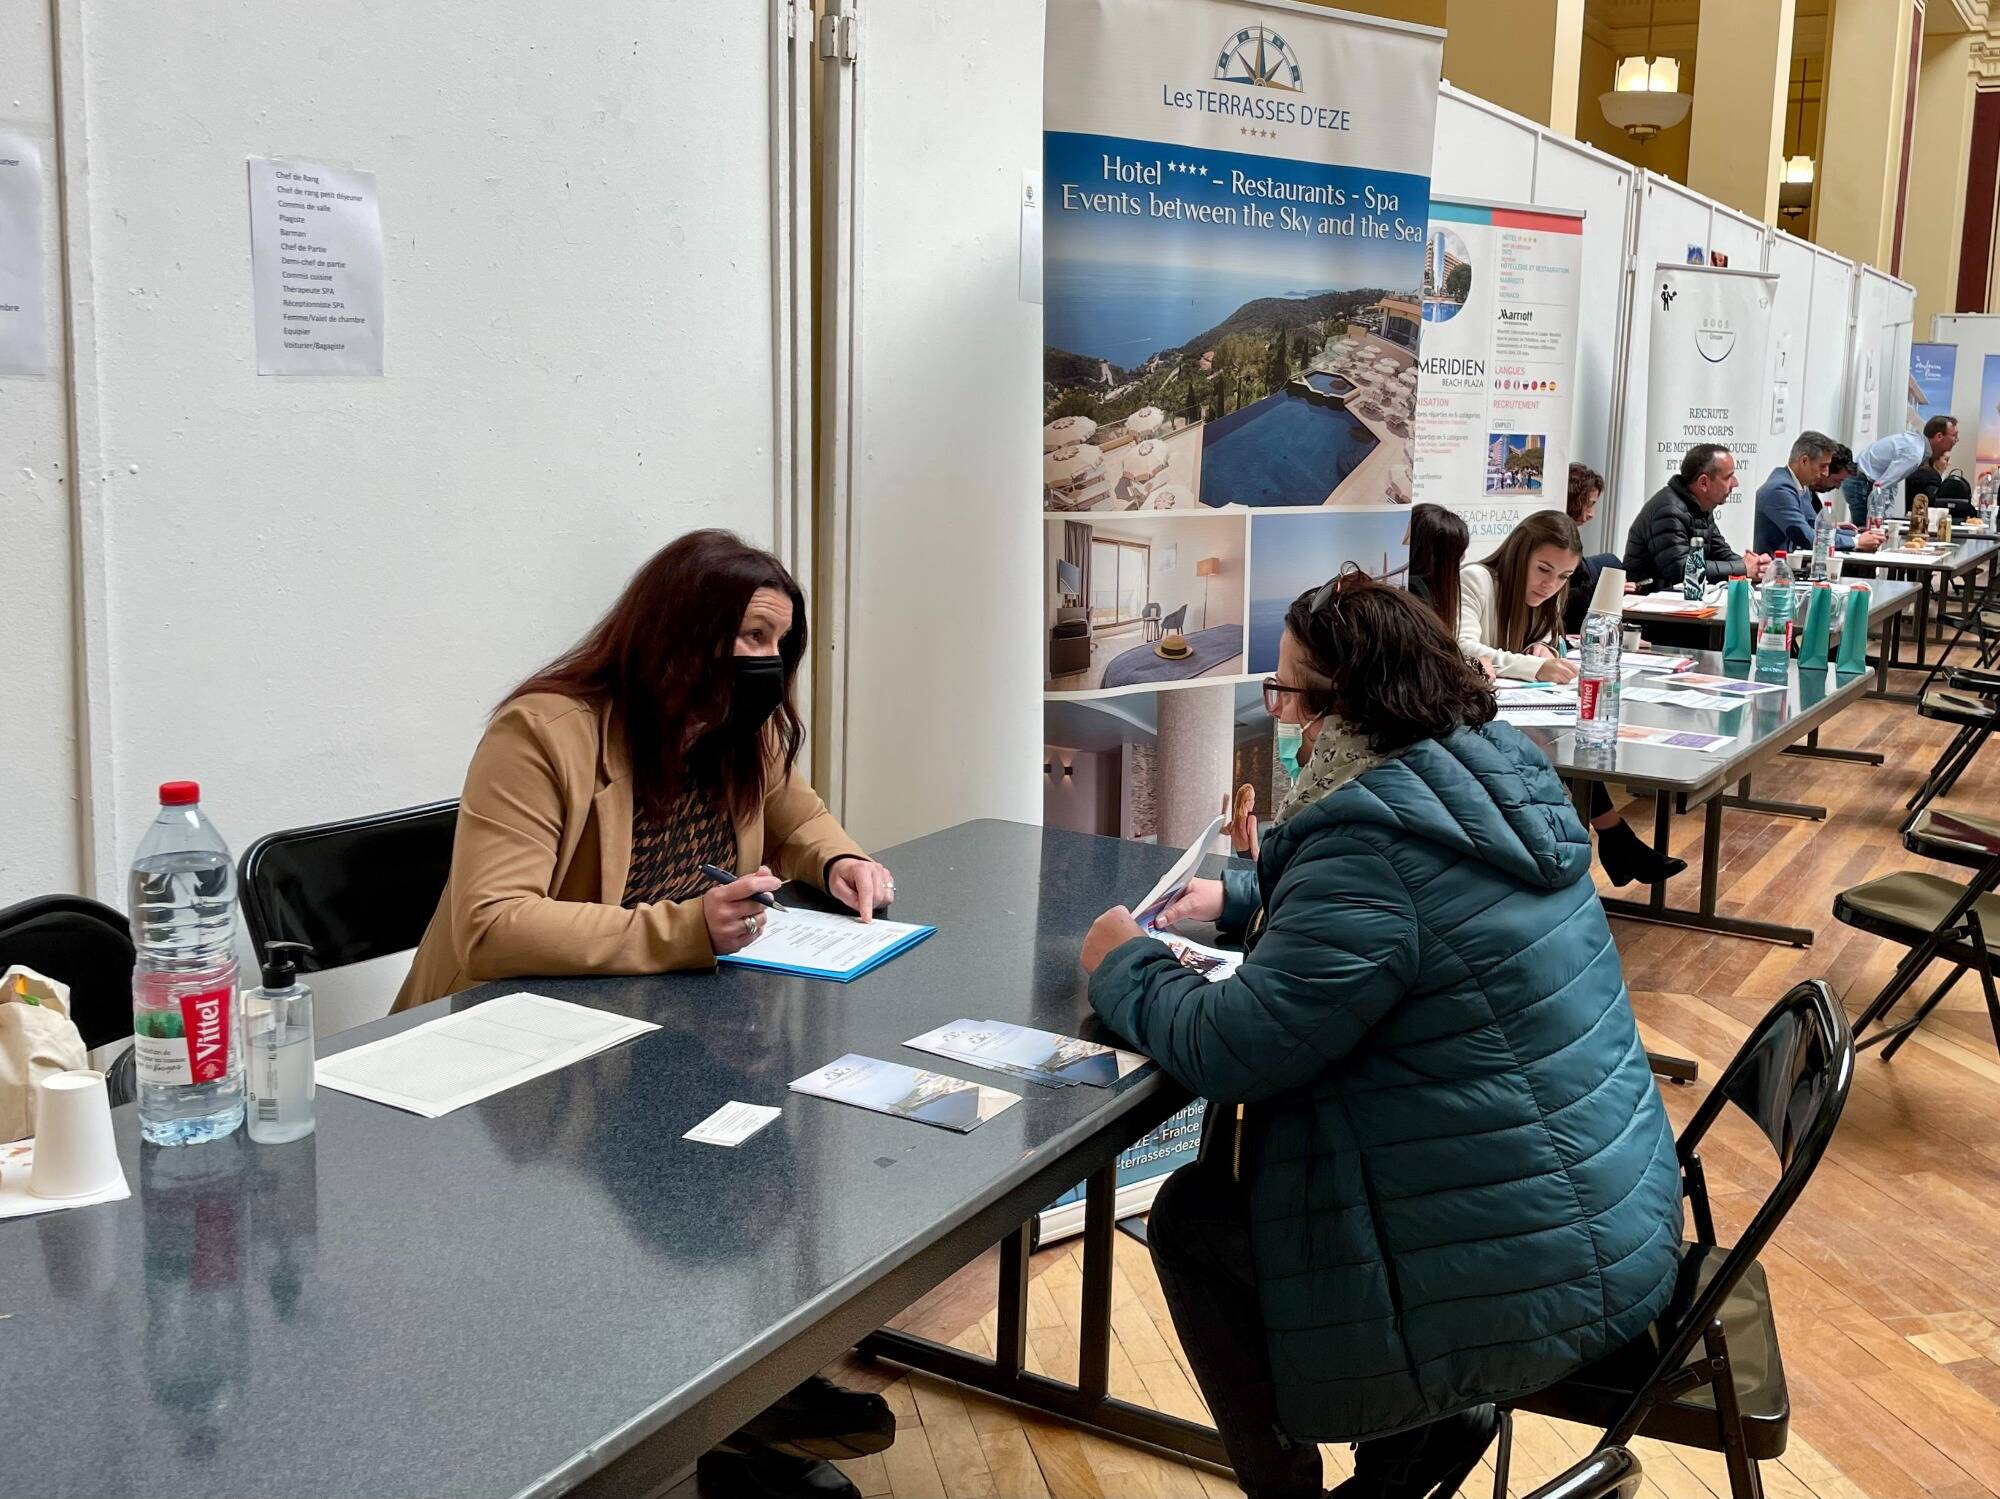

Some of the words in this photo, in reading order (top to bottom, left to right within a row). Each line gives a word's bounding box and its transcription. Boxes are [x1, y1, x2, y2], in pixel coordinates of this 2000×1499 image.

[1163, 84, 1193, 109] Les
[1196, 89, 1296, 124] TERRASSES
[1300, 105, 1351, 131] D'EZE
[275, 171, 292, 180] Chef
[293, 173, 302, 181] de
[303, 174, 320, 184] Rang
[1102, 154, 1161, 186] Hotel
[1231, 170, 1346, 207] Restaurants
[1364, 185, 1399, 216] Spa
[277, 185, 293, 194] Chef
[294, 188, 303, 196] de
[304, 191, 319, 199] rang
[278, 200, 305, 210] Commis
[317, 204, 331, 212] salle
[1061, 183, 1142, 216] Events
[1148, 191, 1237, 225] between
[1242, 203, 1274, 229] the
[1280, 206, 1313, 238] Sky
[1317, 213, 1355, 237] and
[1360, 215, 1390, 239] the
[1394, 217, 1422, 243] Sea
[279, 214, 305, 224] Plagiste
[280, 228, 307, 238] Barman
[280, 243, 297, 251] Chef
[297, 244, 307, 252] de
[307, 245, 327, 253] Partie
[281, 257, 316, 266] Demi-chef
[317, 259, 326, 267] de
[326, 260, 346, 268] partie
[282, 271, 309, 280] Commis
[310, 273, 333, 281] cuisine
[321, 287, 335, 295] SPA
[332, 301, 345, 309] SPA
[283, 313, 328, 323] Femme/Valet
[329, 315, 337, 323] de
[338, 316, 365, 324] chambre
[1498, 308, 1533, 321] Marriott
[283, 327, 311, 336] Equipier
[284, 341, 345, 351] Voiturier/Bagagiste
[1418, 357, 1485, 376] MERIDIEN
[1495, 366, 1526, 376] LANGUES
[1442, 378, 1463, 387] BEACH
[1464, 379, 1484, 388] PLAZA
[1493, 399, 1540, 410] RECRUTEMENT
[1689, 408, 1729, 419] RECRUTE
[1682, 425, 1706, 436] TOUS
[1707, 425, 1734, 436] CORPS
[1657, 442, 1672, 453] DE
[1666, 459, 1680, 470] ET
[1490, 509, 1520, 522] PLAZA
[1582, 683, 1594, 710] Vittel
[196, 998, 220, 1062] Vittel
[1162, 1121, 1200, 1141] France
